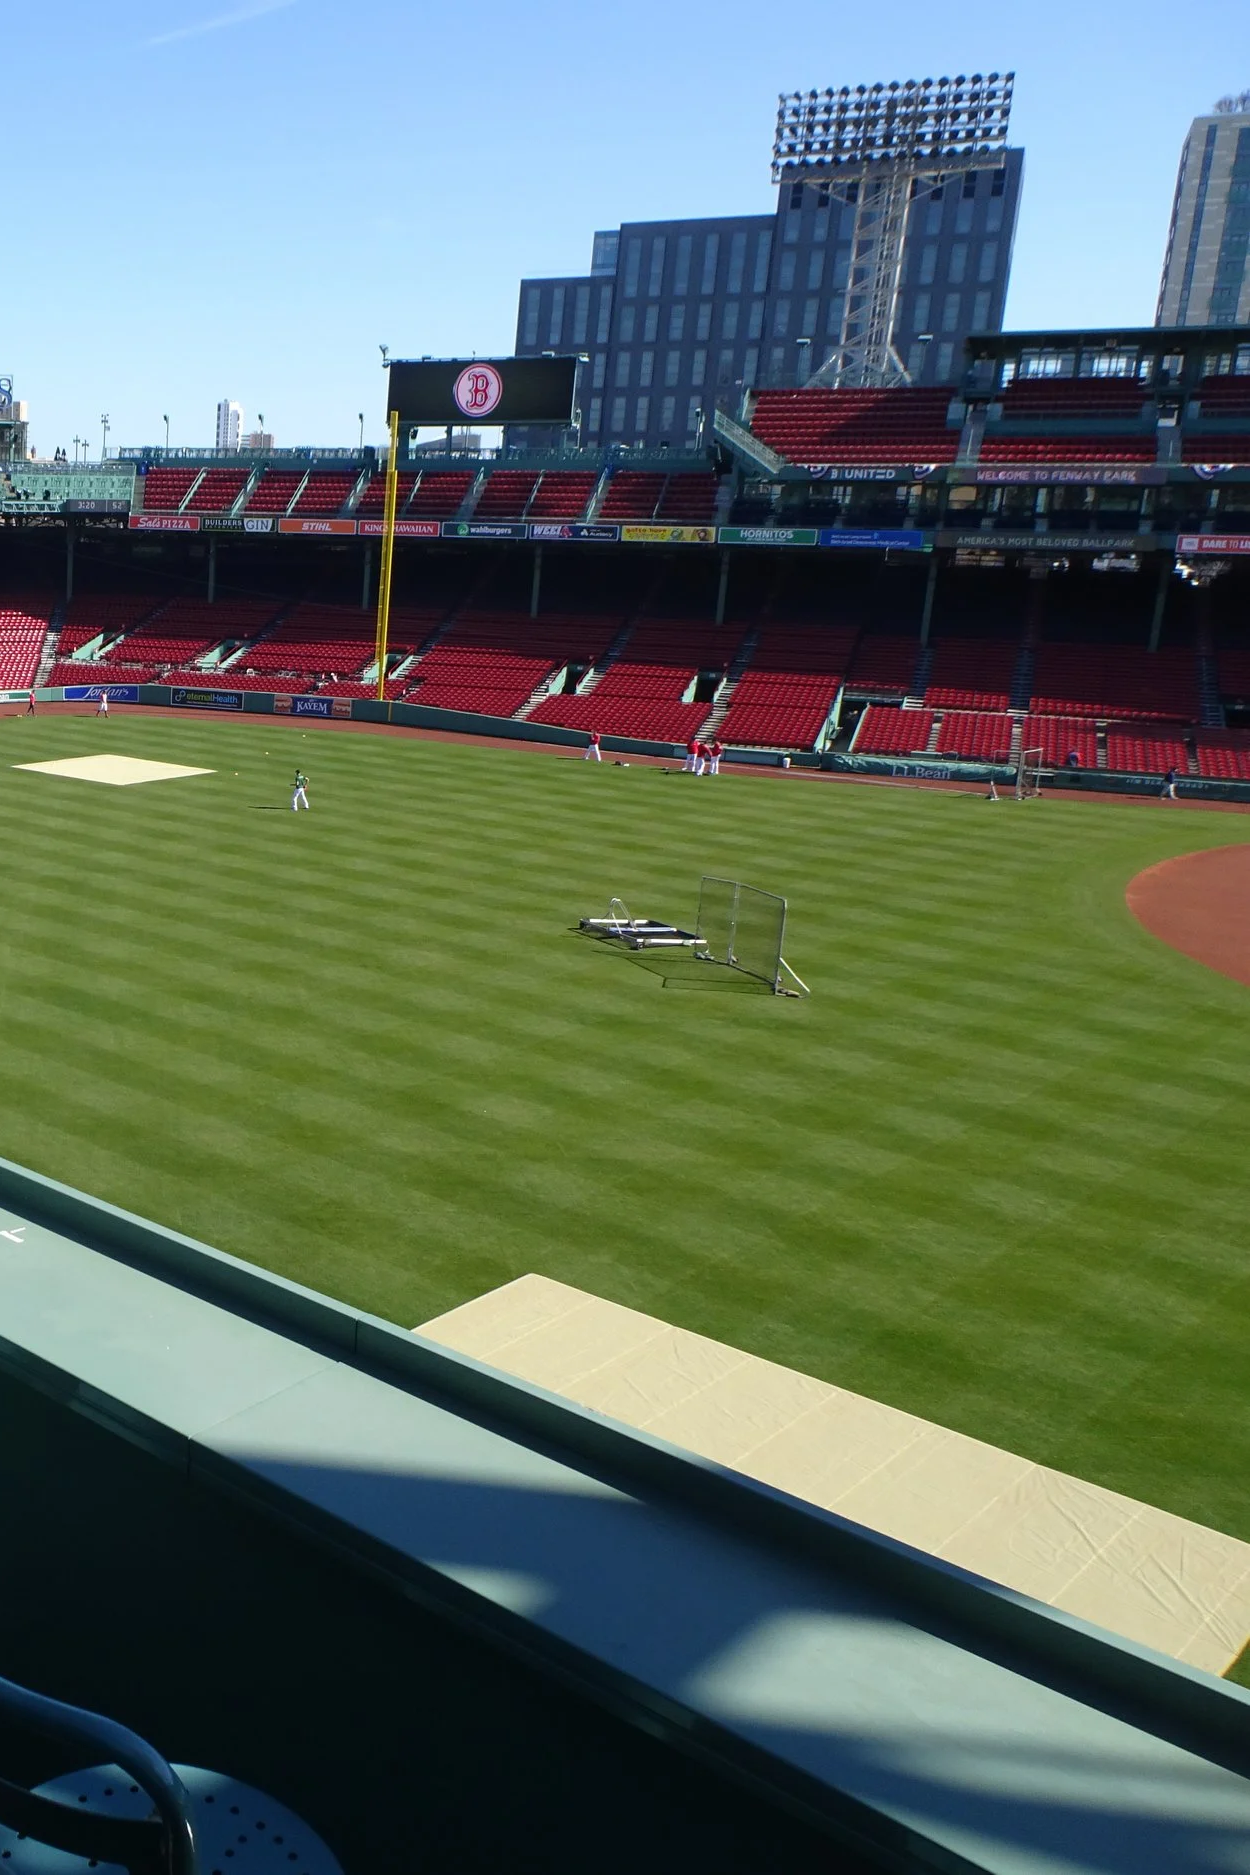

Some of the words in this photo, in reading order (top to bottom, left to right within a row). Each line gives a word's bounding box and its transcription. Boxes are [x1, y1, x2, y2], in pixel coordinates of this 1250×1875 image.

[467, 373, 490, 409] B
[844, 469, 895, 479] UNITED
[977, 471, 1030, 481] WELCOME
[1034, 471, 1048, 480] TO
[1051, 471, 1101, 481] FENWAY
[1103, 471, 1136, 482] PARK
[78, 501, 95, 510] 3:20
[137, 517, 161, 529] Sal's
[162, 520, 191, 529] PIZZA
[245, 519, 270, 530] GIN
[302, 522, 332, 531] STIHL
[392, 524, 434, 533] HAWAIIAN
[470, 526, 512, 535] wahlburgers
[533, 525, 561, 535] WEEI
[740, 529, 794, 539] HORNITOS
[957, 537, 1005, 545] AMERICA'S
[1036, 538, 1079, 546] BELOVED
[1082, 539, 1135, 547] BALLPARK
[1202, 540, 1227, 548] DARE
[186, 693, 238, 703] eternalHealth
[296, 701, 328, 714] KAYEM
[891, 765, 950, 780] L.L.Bean
